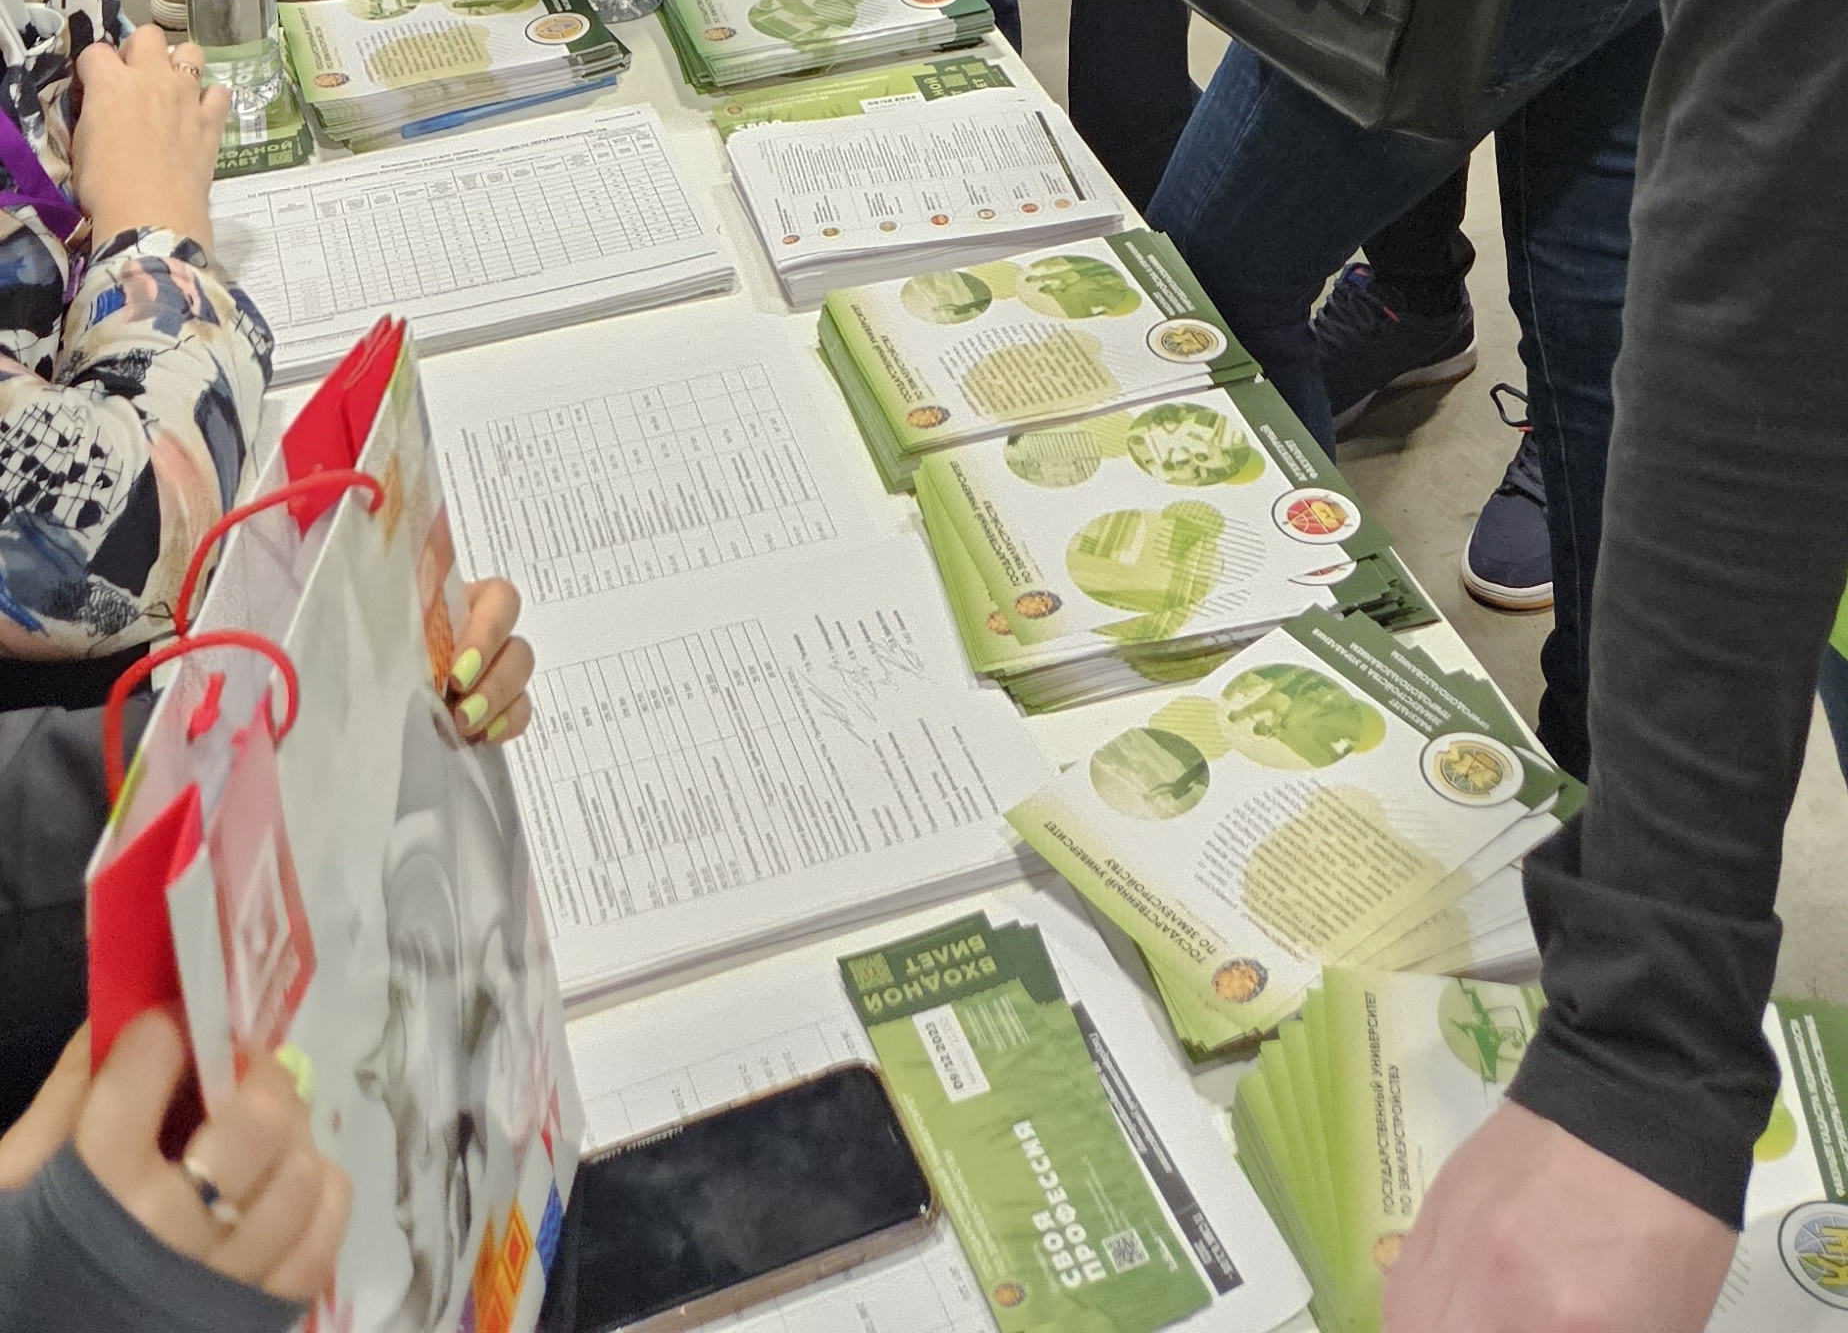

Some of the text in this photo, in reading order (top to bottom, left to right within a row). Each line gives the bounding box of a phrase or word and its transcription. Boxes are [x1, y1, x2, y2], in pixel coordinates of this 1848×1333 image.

[1044, 820, 1108, 880] УНИВЕРСИТЕТ
[1104, 858, 1200, 939] ЗЕМЛЕУСТРОЙСТВУ
[1105, 876, 1208, 964] ГОСУДАРСТВЕННЫЙ
[863, 955, 998, 1016] ВХОДНОЙ
[905, 933, 987, 976] БИЛЕТ
[1199, 938, 1218, 956] ПО
[1365, 991, 1395, 1217] ГОСУДАРСТВЕННЫЙ УНИВЕРСИТЕТ
[1388, 1064, 1413, 1218] ПО ЗЕМЛЕУСТРОЙСТВУ
[1012, 1119, 1107, 1282] ПРОФЕССИЯ
[1031, 1209, 1082, 1289] СВОЯ
